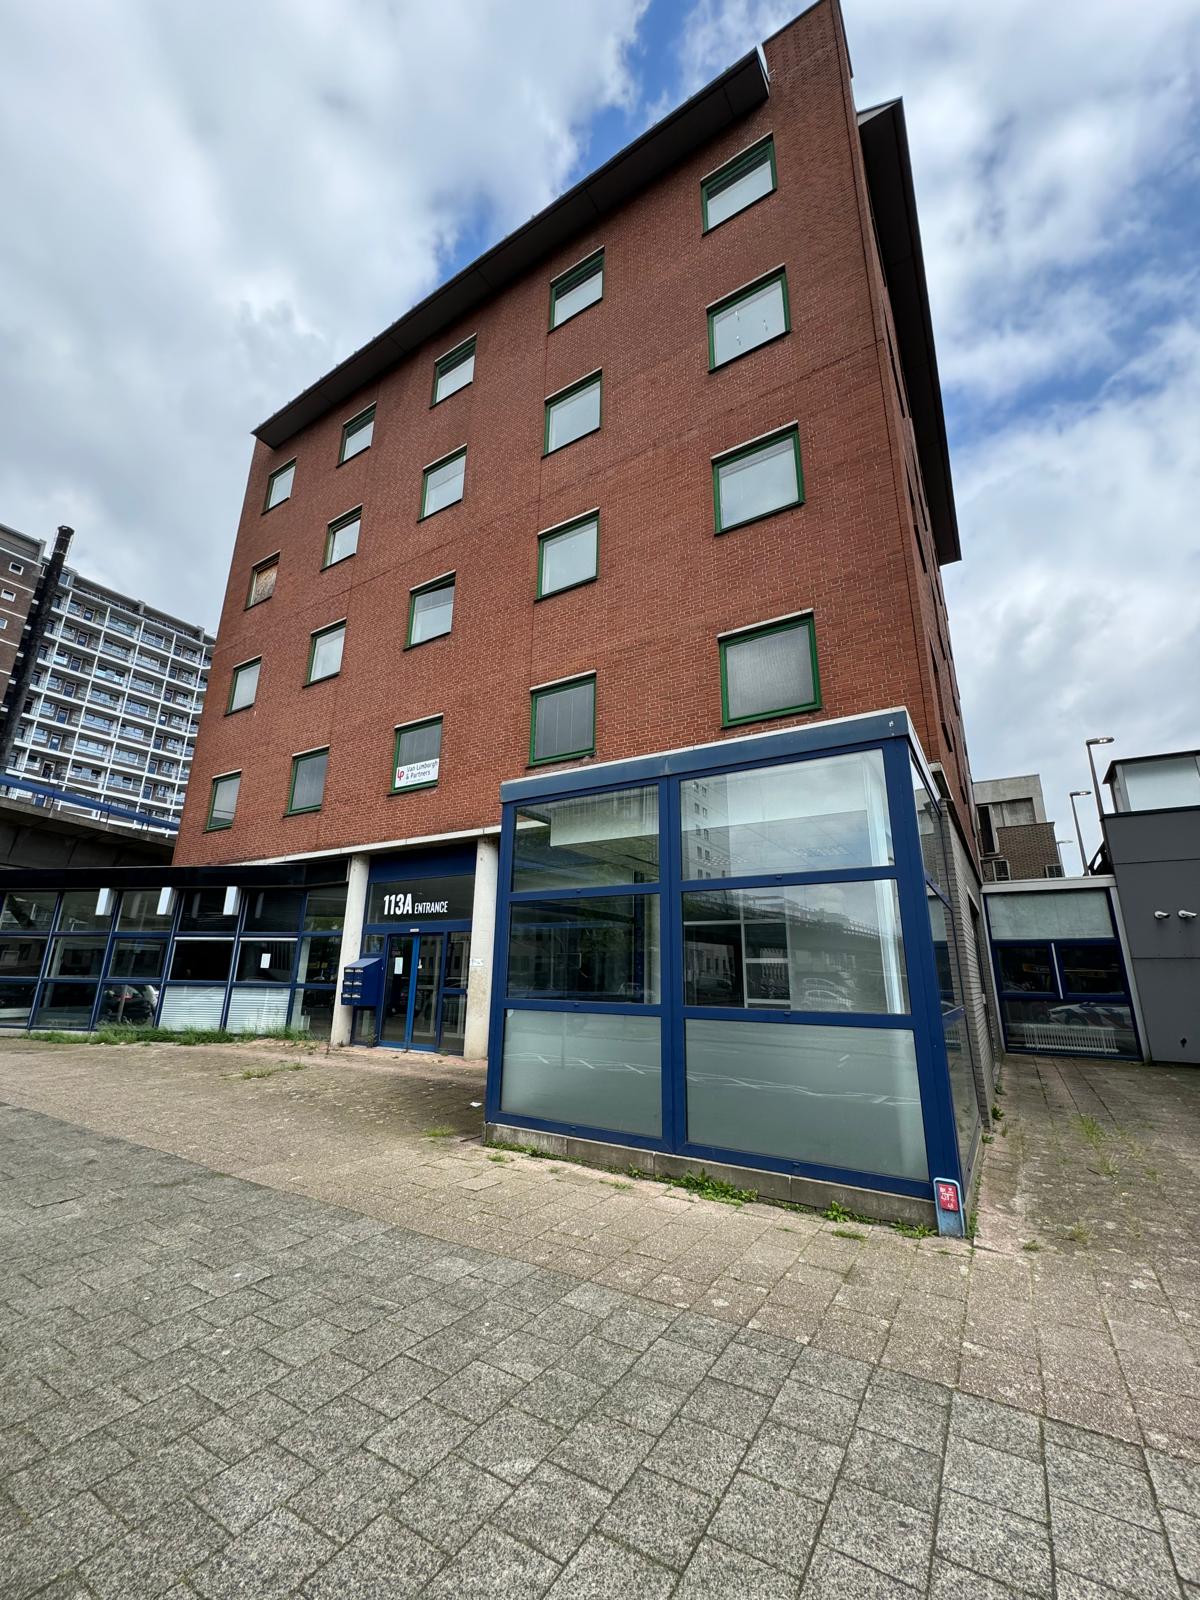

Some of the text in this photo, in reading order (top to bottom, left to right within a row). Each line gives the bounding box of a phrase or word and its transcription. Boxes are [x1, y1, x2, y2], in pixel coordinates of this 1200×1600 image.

[411, 770, 430, 778] Partners
[384, 893, 449, 915] 113A ENTRANCE
